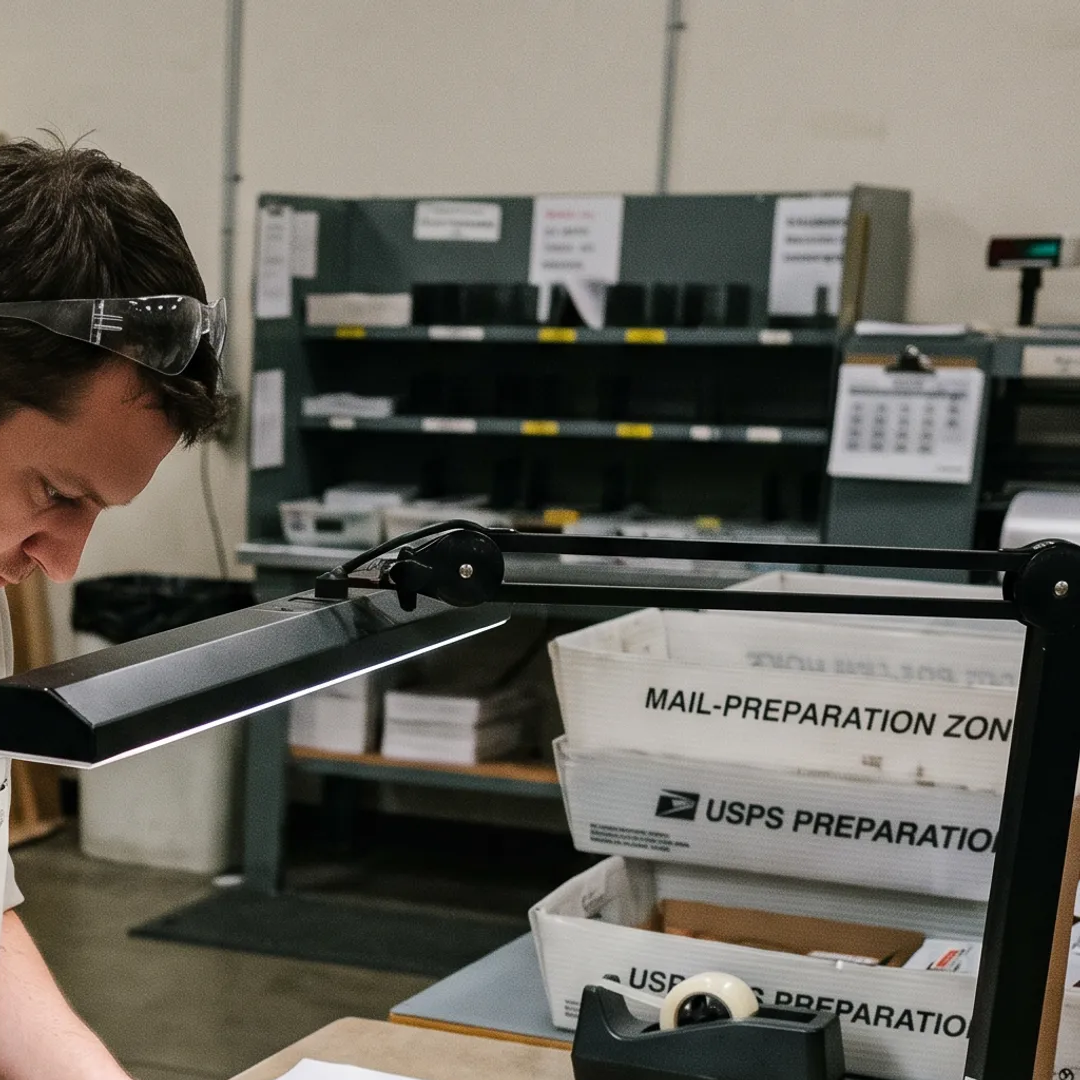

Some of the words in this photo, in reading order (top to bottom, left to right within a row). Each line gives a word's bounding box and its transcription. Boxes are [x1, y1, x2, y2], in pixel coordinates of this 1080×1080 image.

[645, 688, 936, 736] MAIL-PREPARATION
[706, 799, 784, 830] USPS
[792, 810, 997, 853] PREPARATIO
[774, 991, 972, 1039] PREPARATIO
